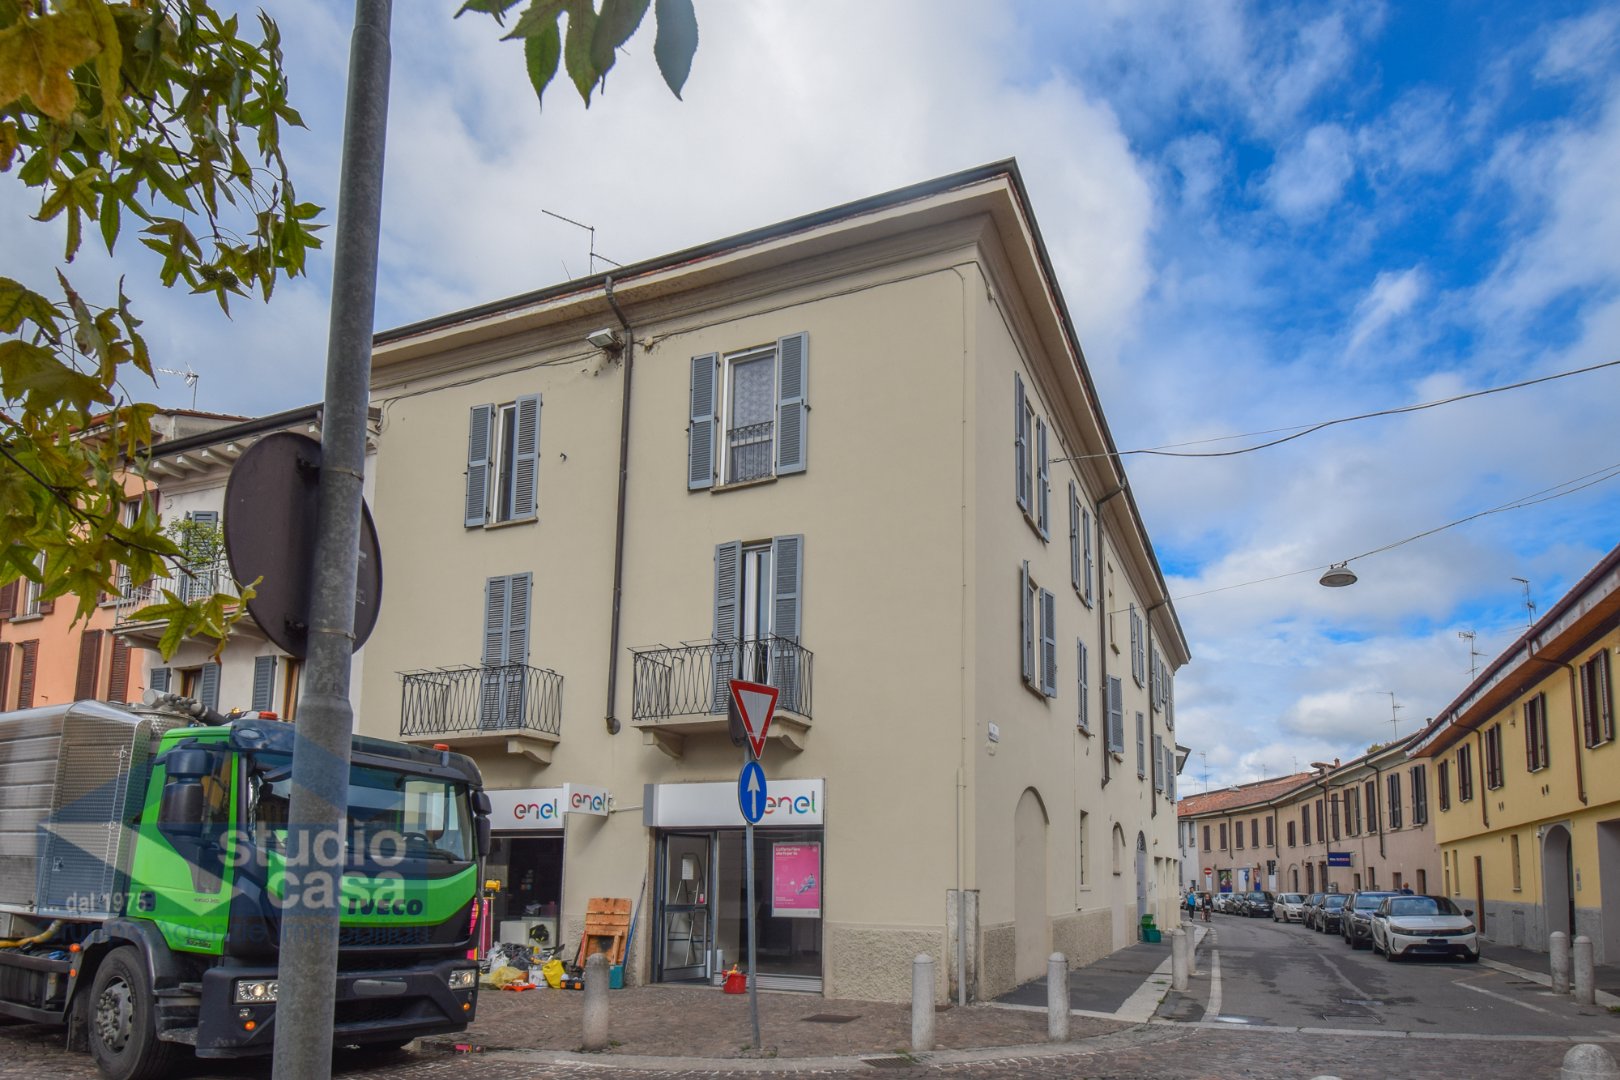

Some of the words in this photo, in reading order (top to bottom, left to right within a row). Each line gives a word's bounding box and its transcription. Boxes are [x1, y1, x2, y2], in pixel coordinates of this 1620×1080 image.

[514, 798, 558, 819] enel
[571, 792, 606, 811] enel
[764, 790, 816, 814] enel
[348, 898, 423, 916] IVECO
